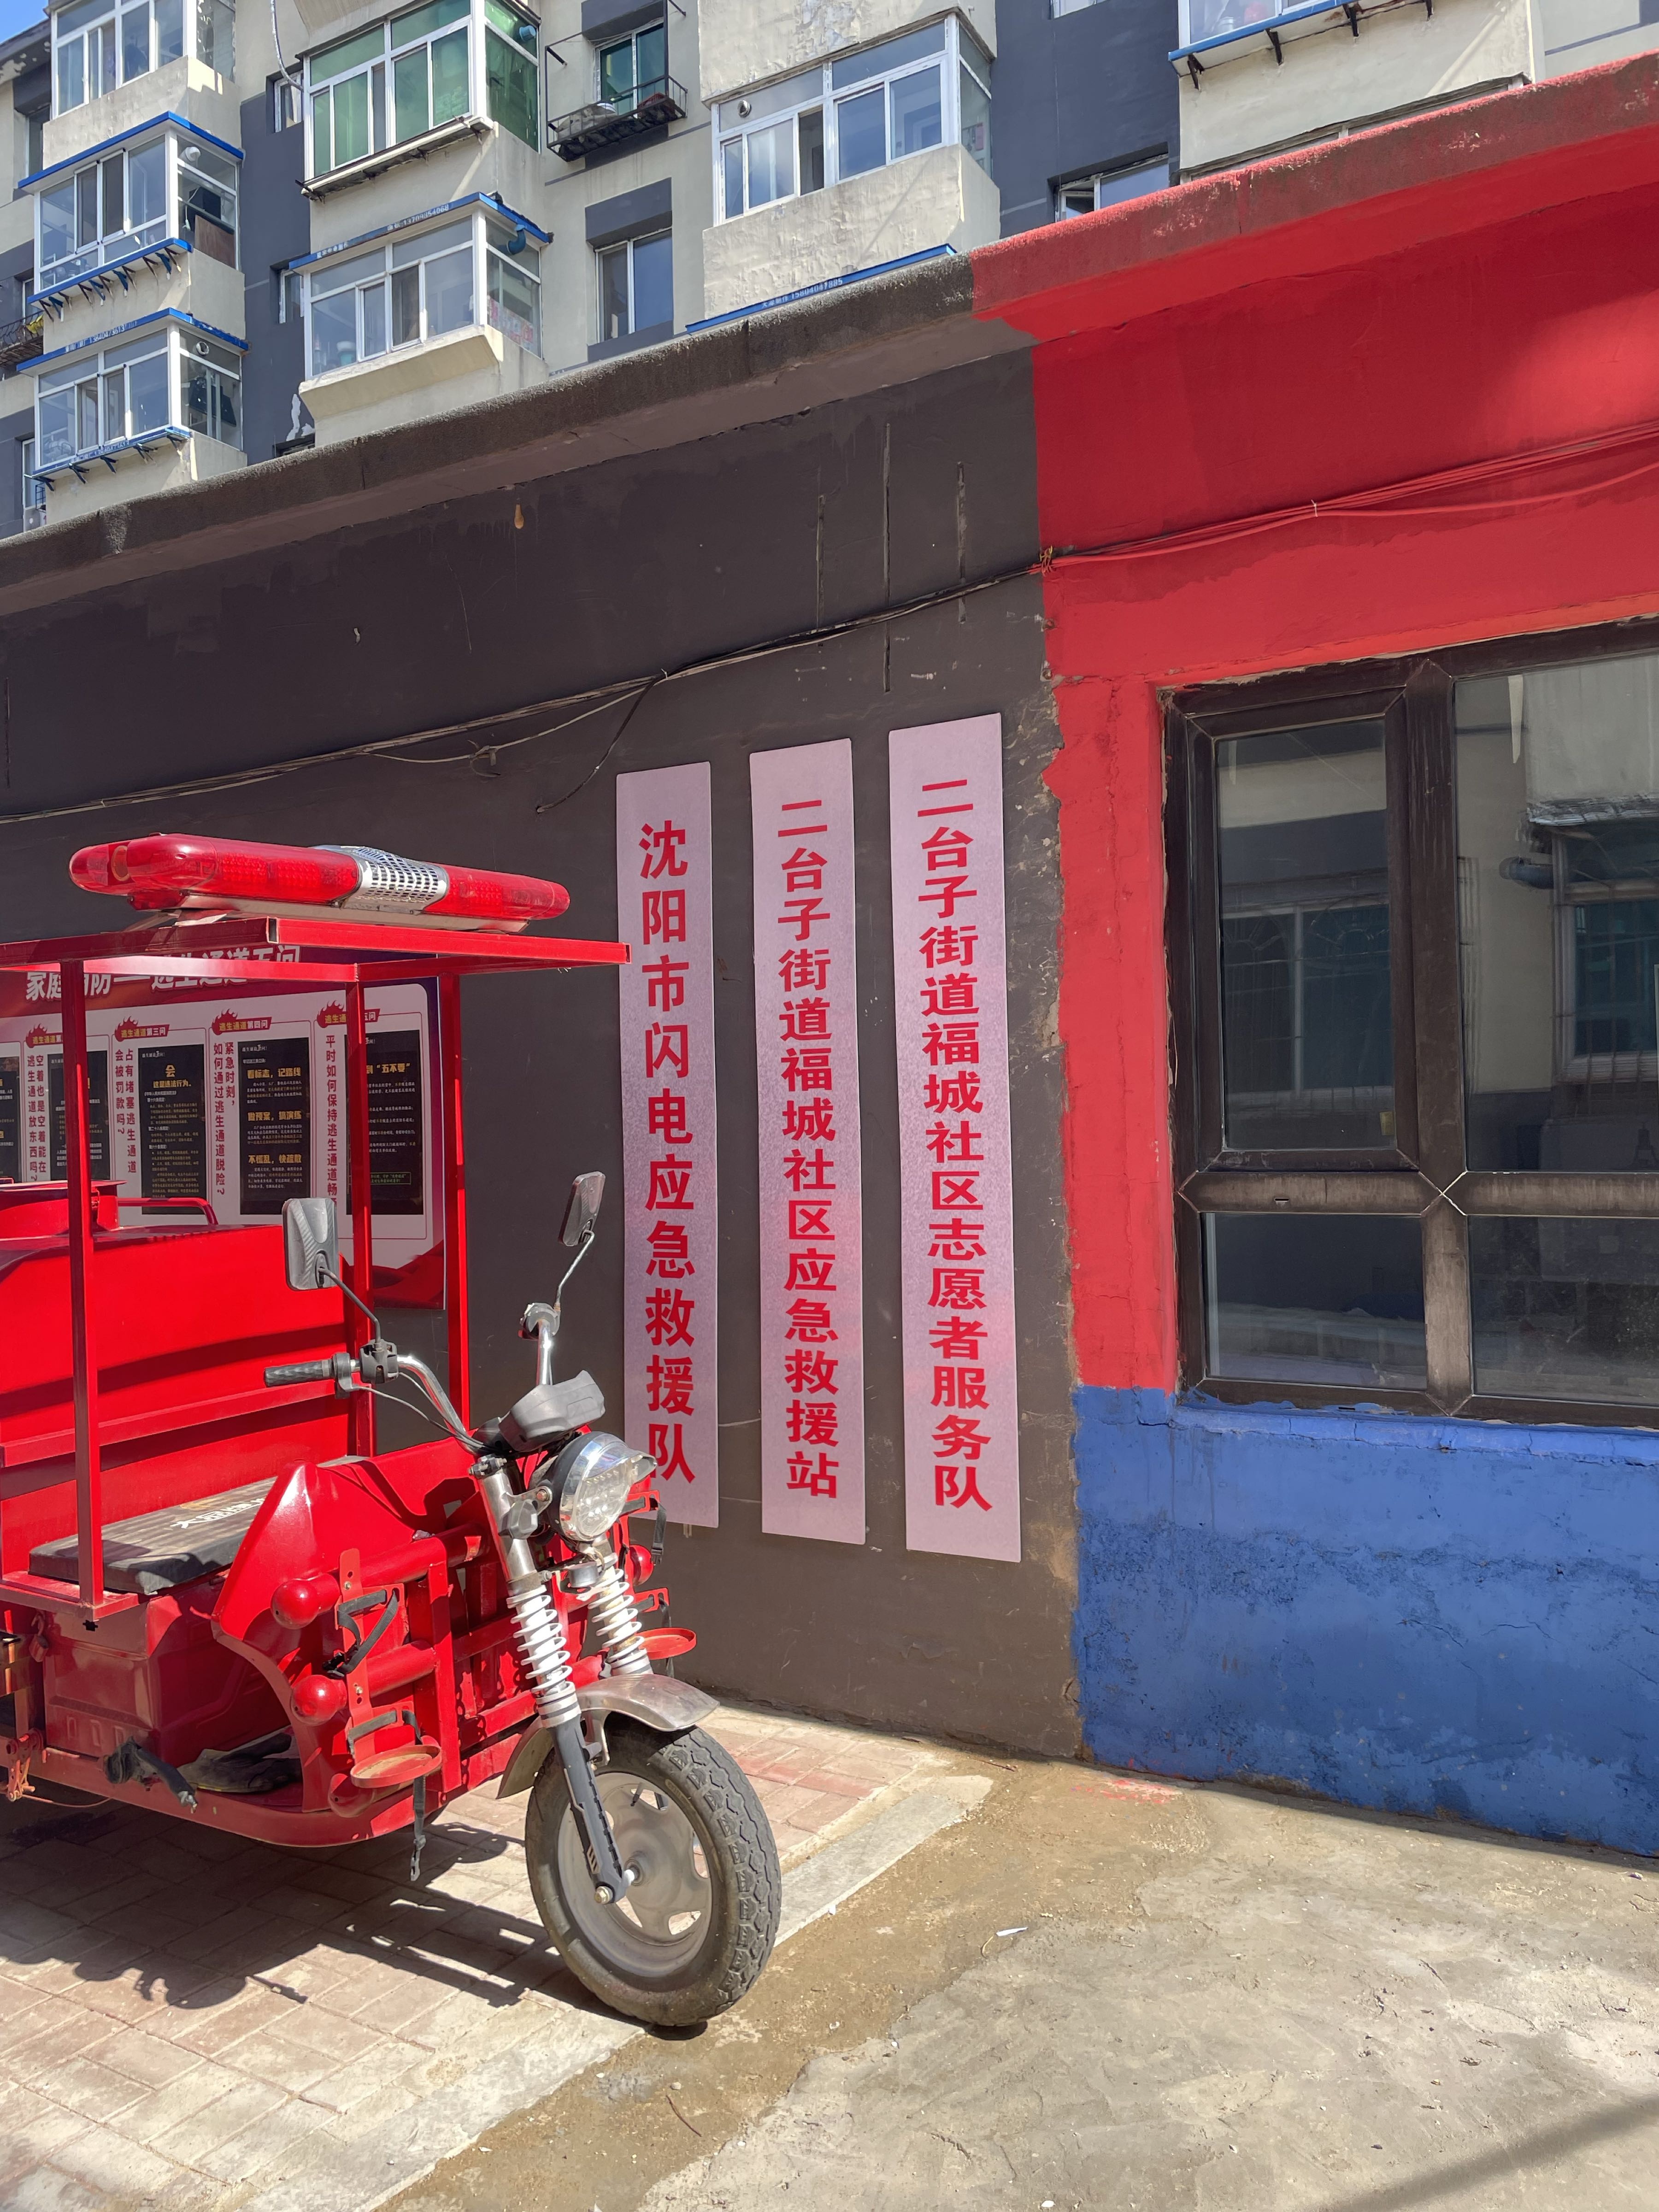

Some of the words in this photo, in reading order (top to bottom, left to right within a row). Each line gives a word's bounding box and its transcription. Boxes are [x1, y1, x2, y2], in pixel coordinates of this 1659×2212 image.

[121, 1027, 166, 1038] 逃生通道第三问
[165, 1064, 176, 1078] 会
[219, 1019, 268, 1031] 逃生通道第四问
[36, 1055, 47, 1173] 空着也是空着能在
[125, 1048, 136, 1173] 占有堵塞逃生通道
[326, 1035, 337, 1206] 平时如何保持逃生通道畅
[639, 820, 695, 1484] 沈阳市闪电应急救援队
[778, 799, 840, 1499] 二台子街道福城社区应急救援站
[918, 779, 993, 1512] 二台子街道福城社区志愿者服务队
